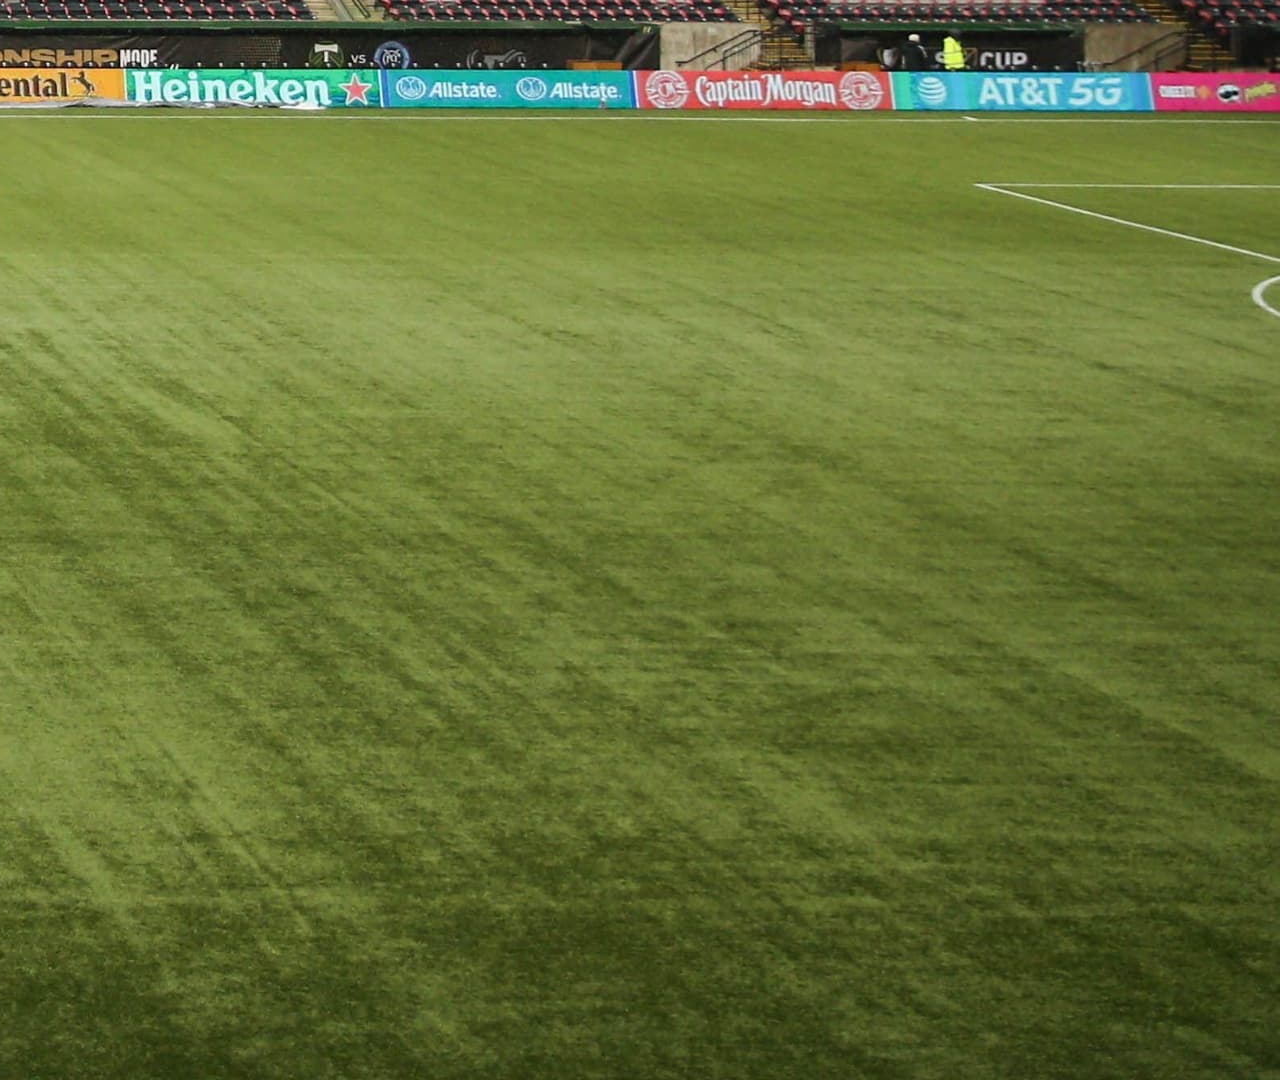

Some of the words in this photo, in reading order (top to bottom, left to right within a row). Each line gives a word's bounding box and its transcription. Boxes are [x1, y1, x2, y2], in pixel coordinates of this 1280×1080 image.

[120, 49, 158, 68] MODE
[980, 51, 1028, 69] CUP
[131, 70, 331, 106] Heineken
[428, 82, 497, 99] Allstate
[549, 82, 618, 99] Allstate
[695, 74, 763, 106] Captain
[762, 73, 836, 105] Morgan
[979, 78, 1064, 106] AT&T
[1068, 78, 1123, 106] 5G
